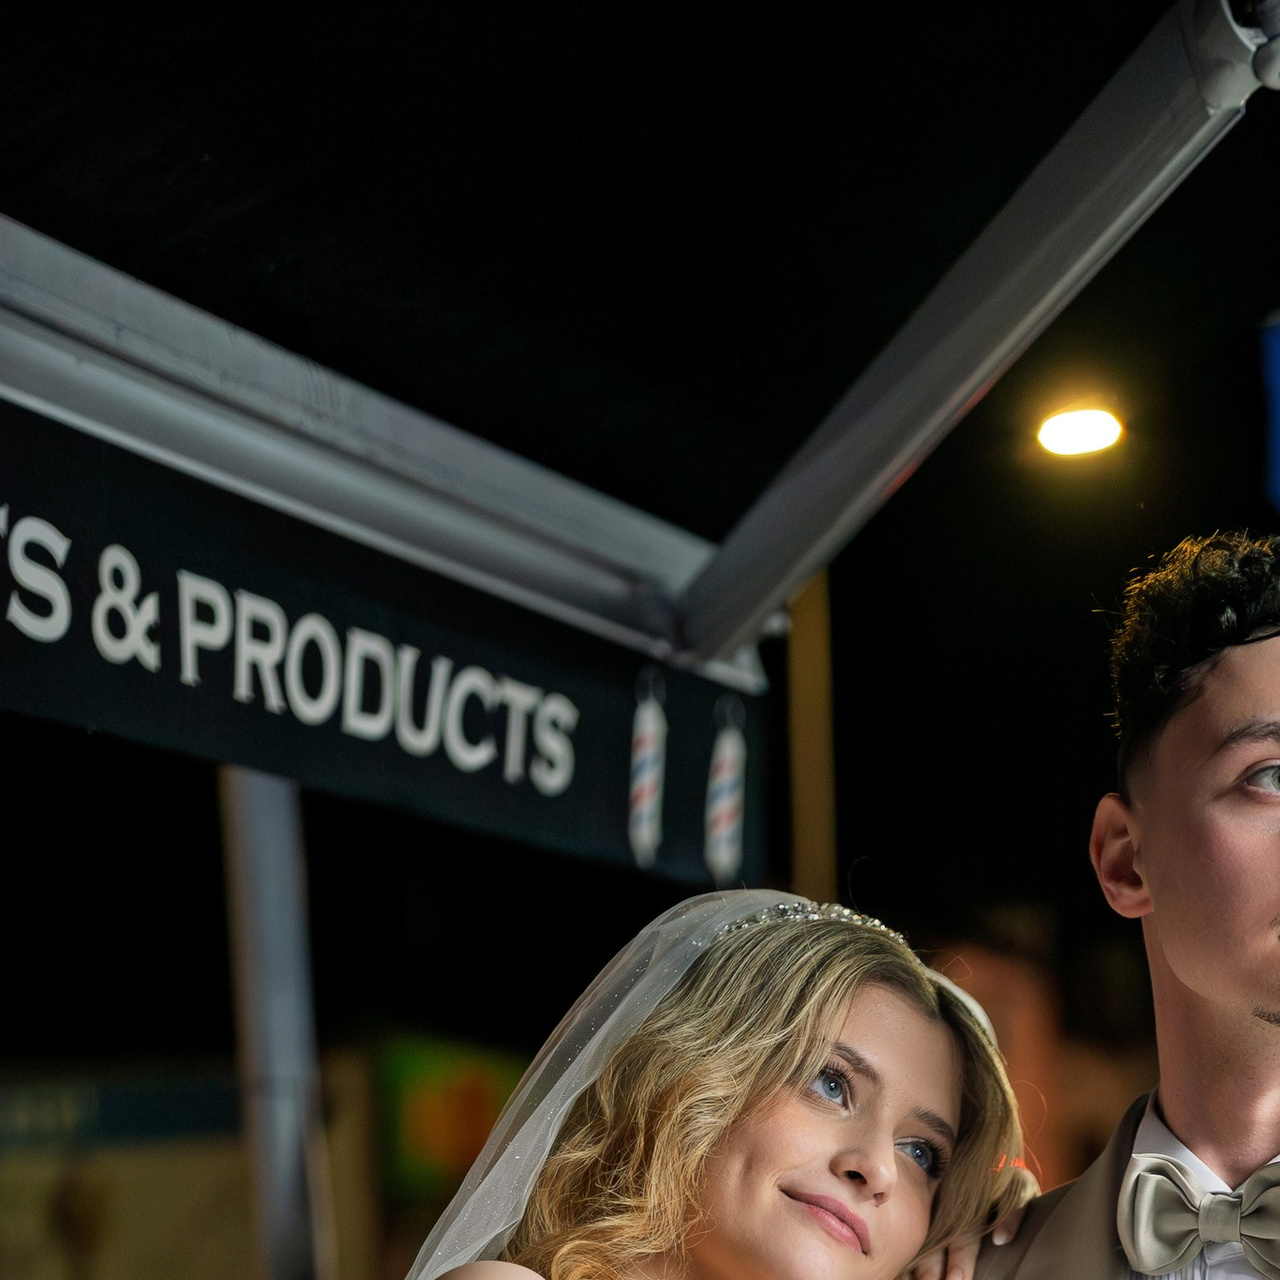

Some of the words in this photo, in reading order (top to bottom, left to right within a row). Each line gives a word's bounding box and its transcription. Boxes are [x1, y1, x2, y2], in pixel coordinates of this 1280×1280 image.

[0, 505, 72, 642] S
[91, 544, 161, 673] &
[176, 569, 580, 796] PRODUCTS
